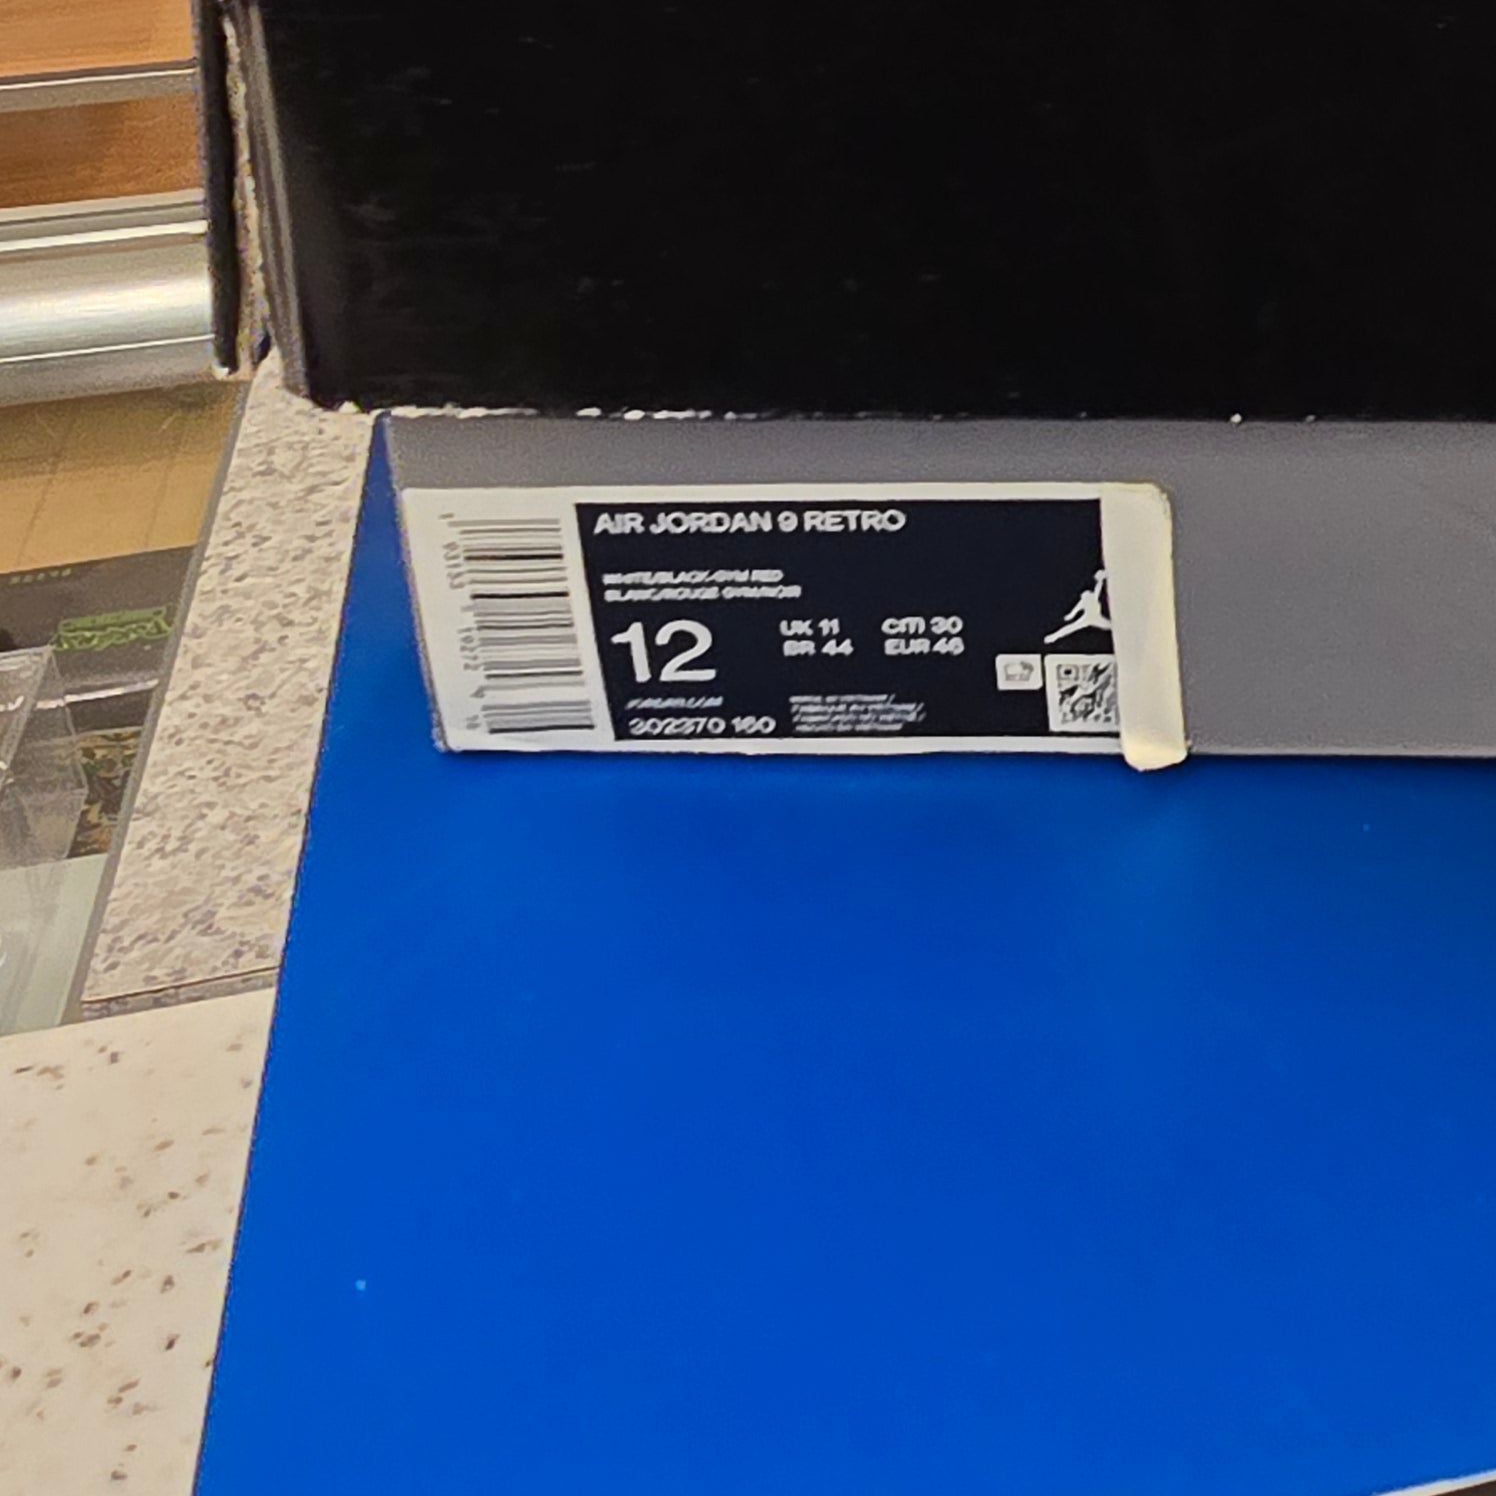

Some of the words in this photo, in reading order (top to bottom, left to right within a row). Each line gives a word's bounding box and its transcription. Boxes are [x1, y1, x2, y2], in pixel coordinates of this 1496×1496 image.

[593, 512, 645, 535] AIR
[649, 510, 773, 535] JORDAN
[777, 511, 799, 532] 9
[803, 508, 907, 533] RETRO
[779, 618, 814, 636] UK
[818, 617, 840, 637] 11
[930, 615, 964, 635] 30
[610, 619, 717, 684] 12
[821, 638, 854, 657] 44
[884, 637, 931, 656] EUR
